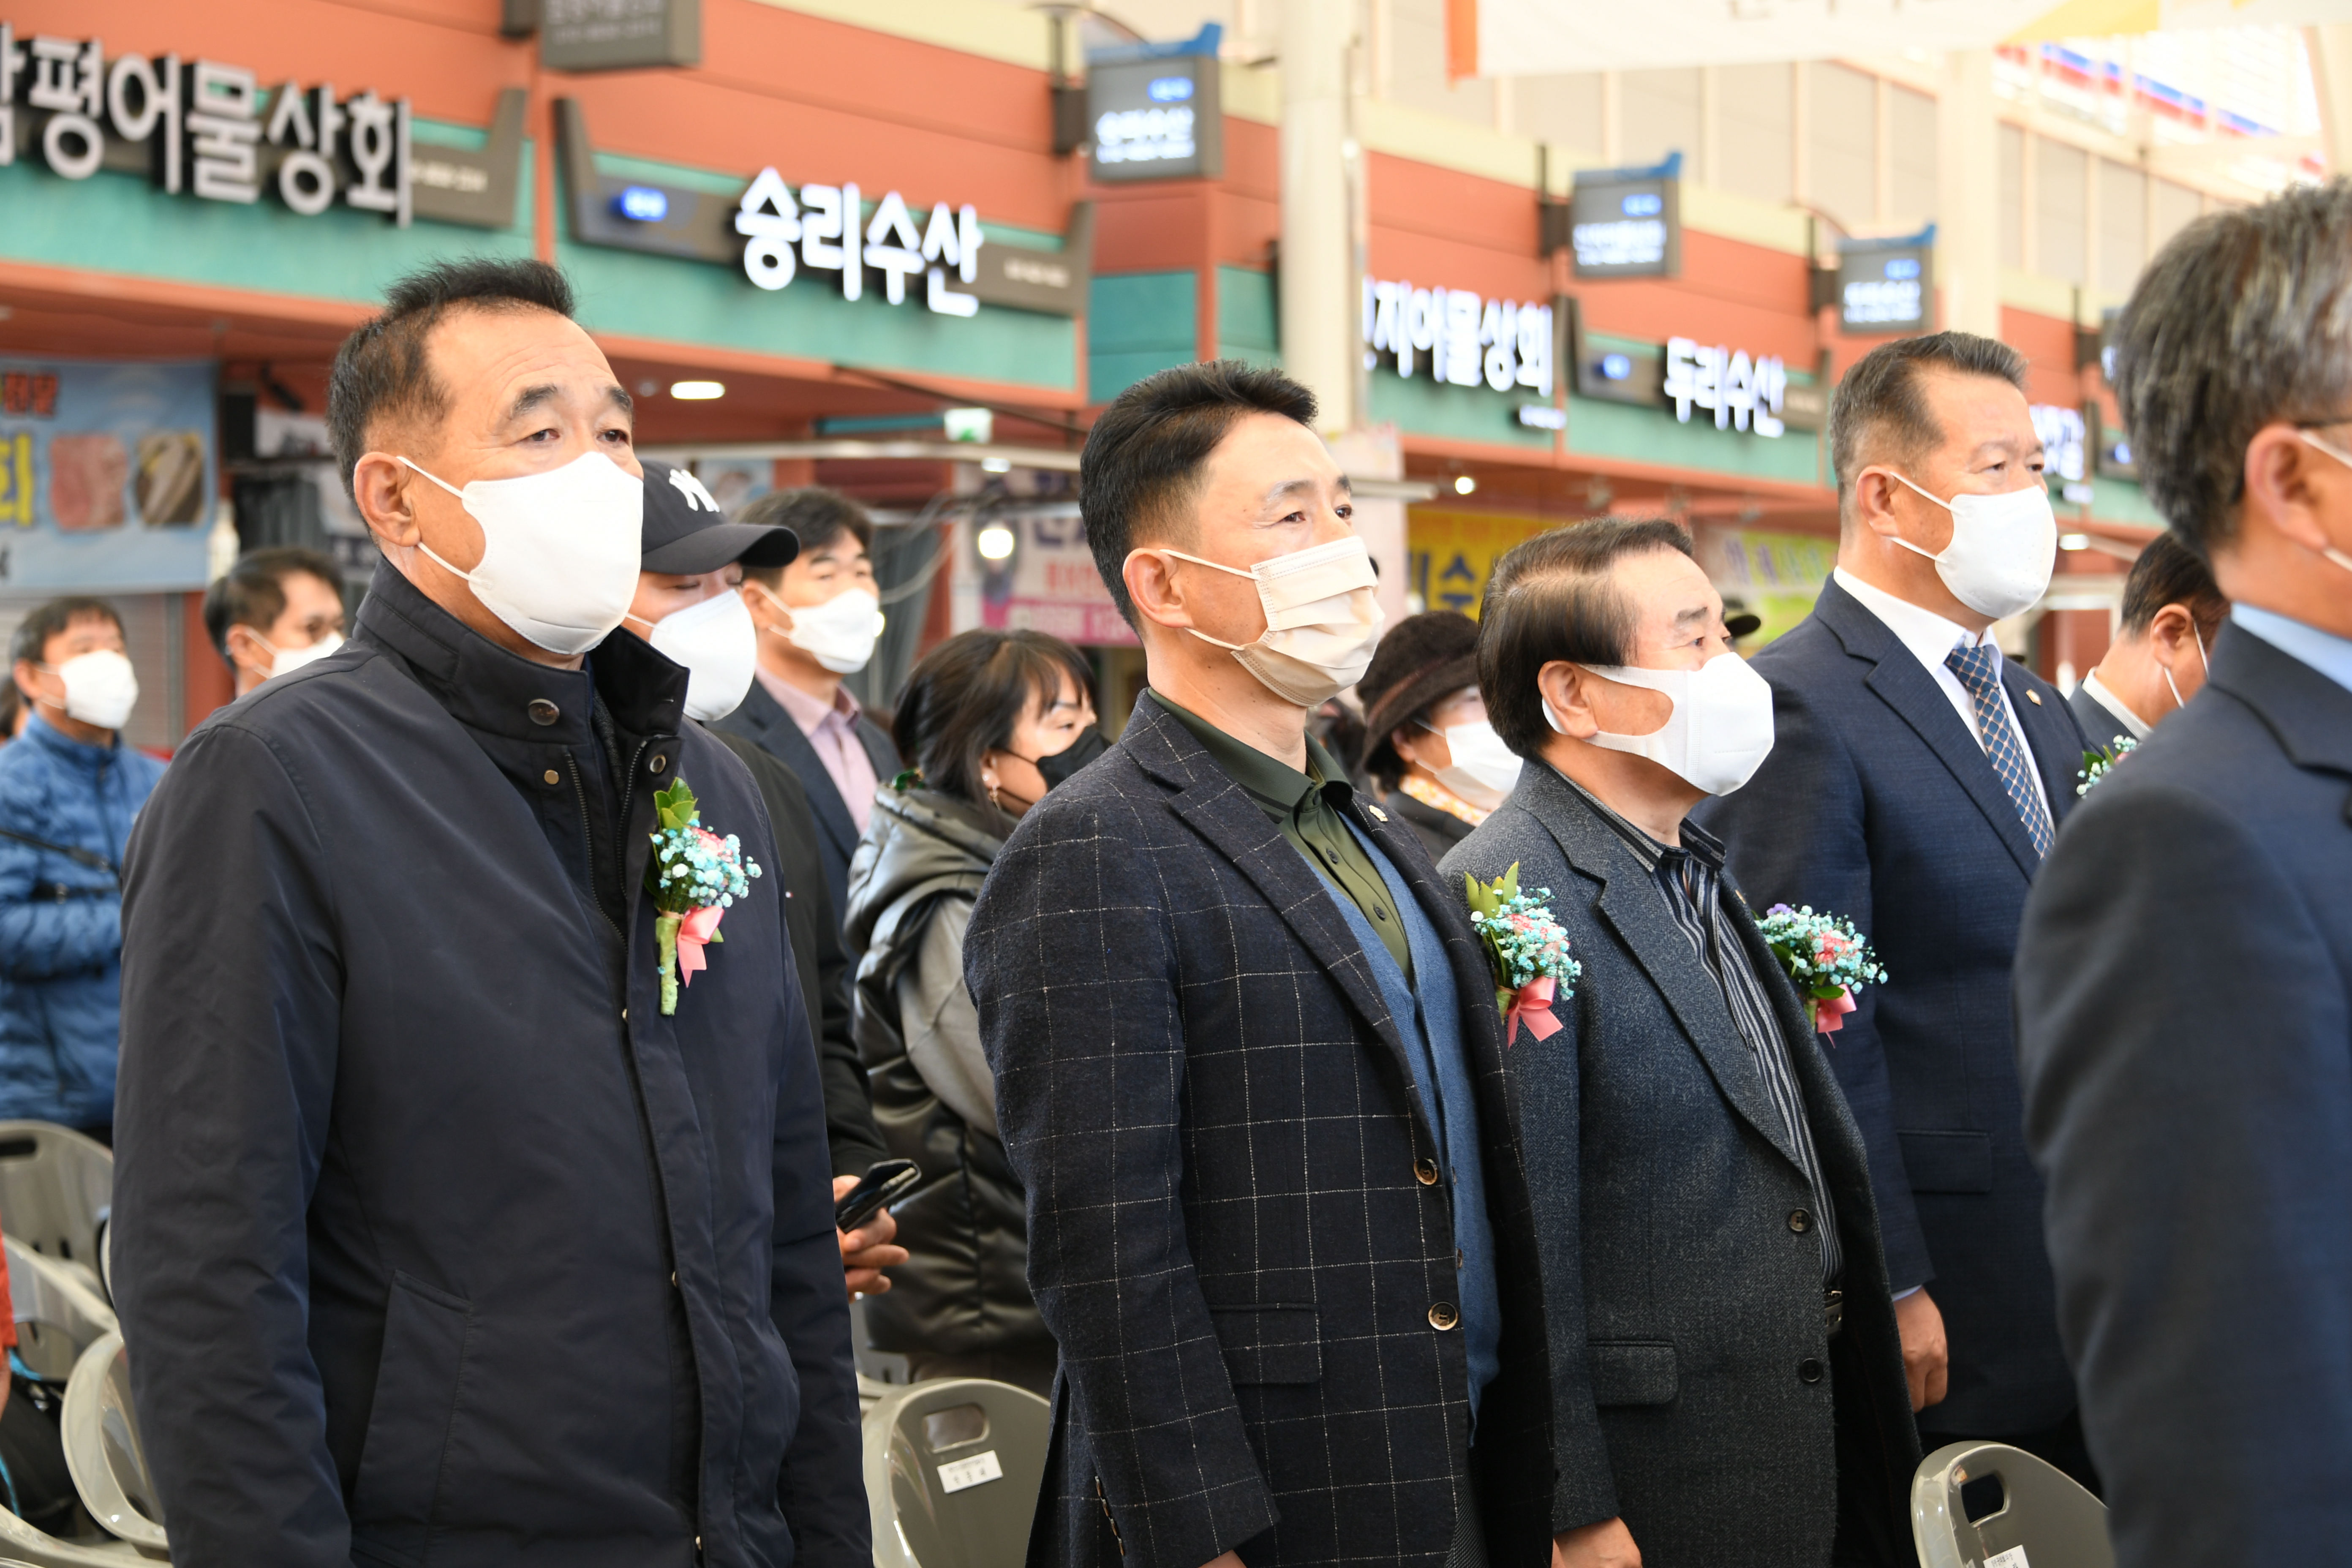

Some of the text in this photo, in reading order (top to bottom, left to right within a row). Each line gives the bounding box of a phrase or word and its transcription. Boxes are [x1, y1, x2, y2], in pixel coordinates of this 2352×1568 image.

[735, 166, 983, 317] 승리수산
[1362, 275, 1553, 398] 지어물상회
[1663, 336, 1787, 438] 두리수산
